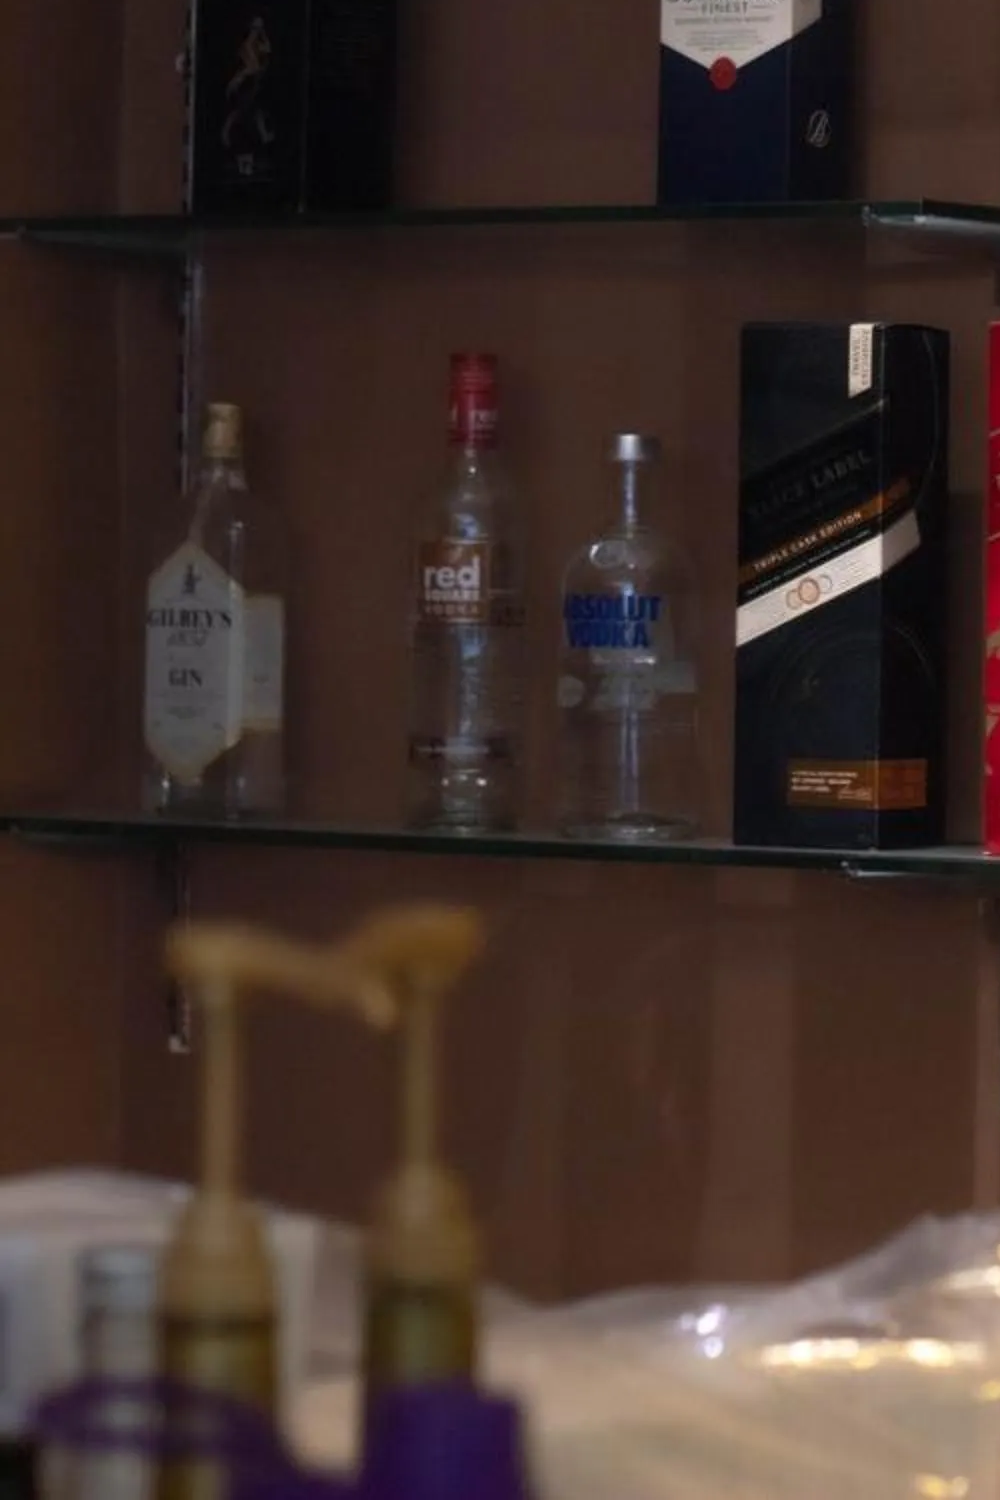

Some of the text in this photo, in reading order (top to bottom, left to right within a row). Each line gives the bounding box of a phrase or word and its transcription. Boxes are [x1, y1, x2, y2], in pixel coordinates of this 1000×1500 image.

[701, 1, 748, 15] FINEST
[424, 554, 481, 590] red
[168, 668, 203, 688] GIN
